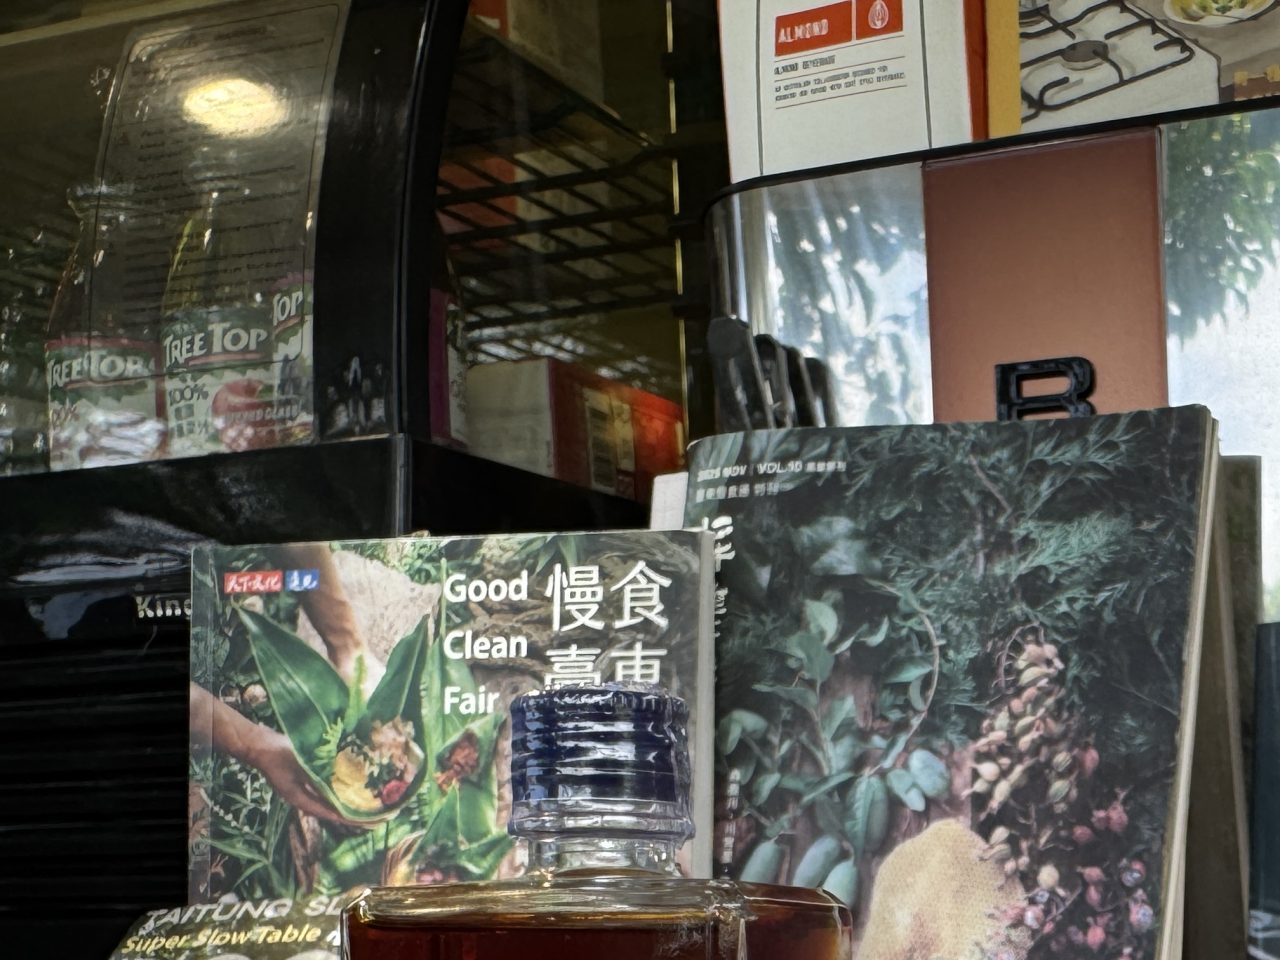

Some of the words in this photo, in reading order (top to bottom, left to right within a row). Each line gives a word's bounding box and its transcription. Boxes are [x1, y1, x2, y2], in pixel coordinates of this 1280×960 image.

[164, 332, 208, 366] TREE
[208, 322, 268, 352] TOP
[444, 572, 527, 603] Good
[544, 560, 673, 632] 慢食
[444, 630, 527, 659] Clean
[444, 686, 499, 715] Fair
[122, 933, 190, 954] Super
[192, 926, 250, 949] Slow
[256, 923, 321, 945] Table
